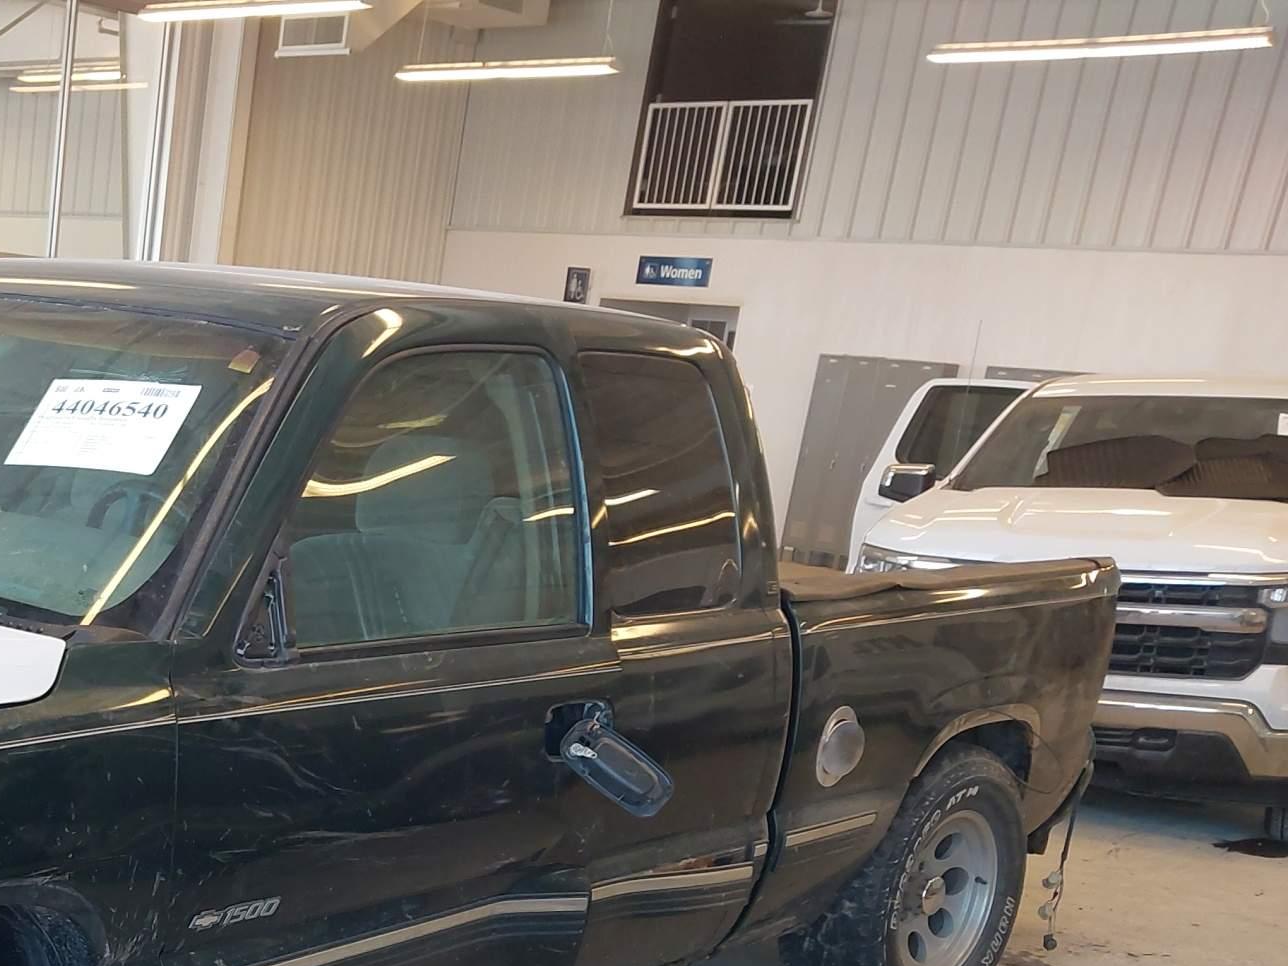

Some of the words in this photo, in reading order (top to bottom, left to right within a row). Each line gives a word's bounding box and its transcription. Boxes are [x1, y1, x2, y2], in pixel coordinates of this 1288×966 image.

[660, 264, 702, 280] Women
[51, 399, 169, 420] 44046540
[222, 896, 282, 928] 1500
